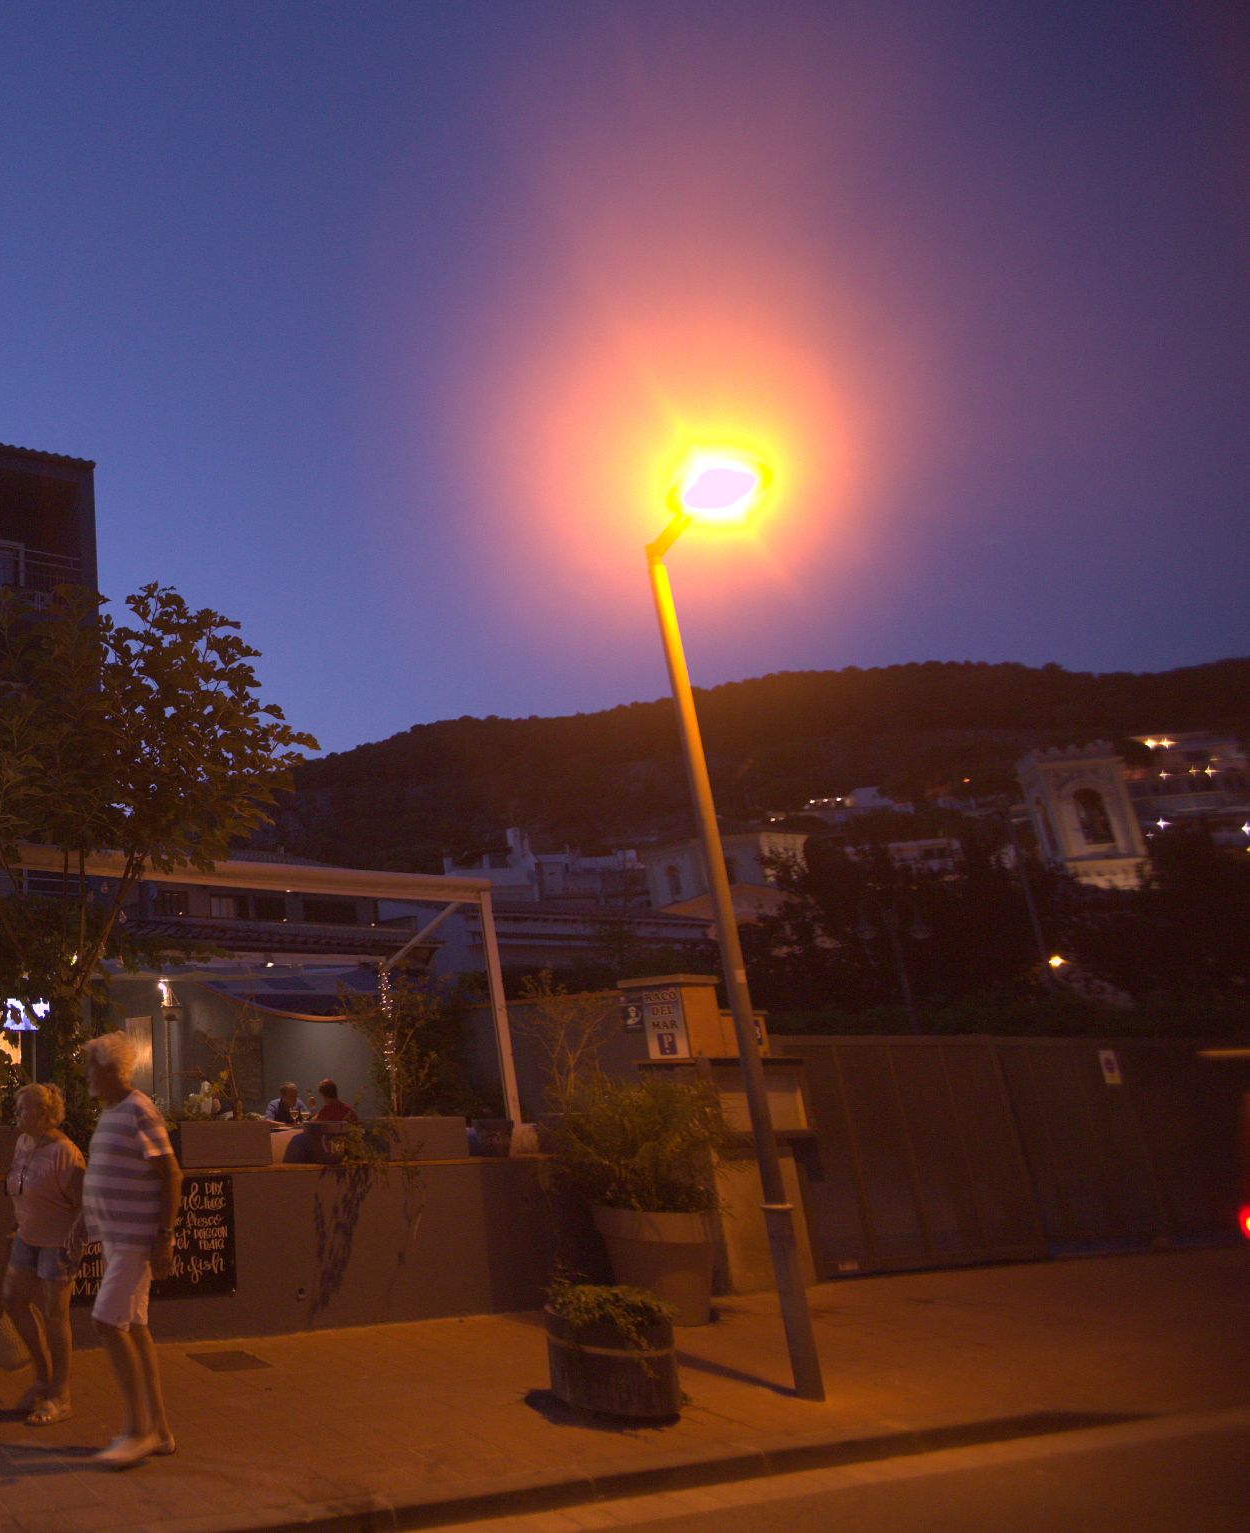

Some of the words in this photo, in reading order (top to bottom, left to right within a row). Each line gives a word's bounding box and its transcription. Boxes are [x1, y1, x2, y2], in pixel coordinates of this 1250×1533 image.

[652, 1006, 675, 1017] DEL
[652, 1019, 679, 1031] MAR
[186, 1211, 222, 1229] fresco
[187, 1251, 225, 1285] fish
